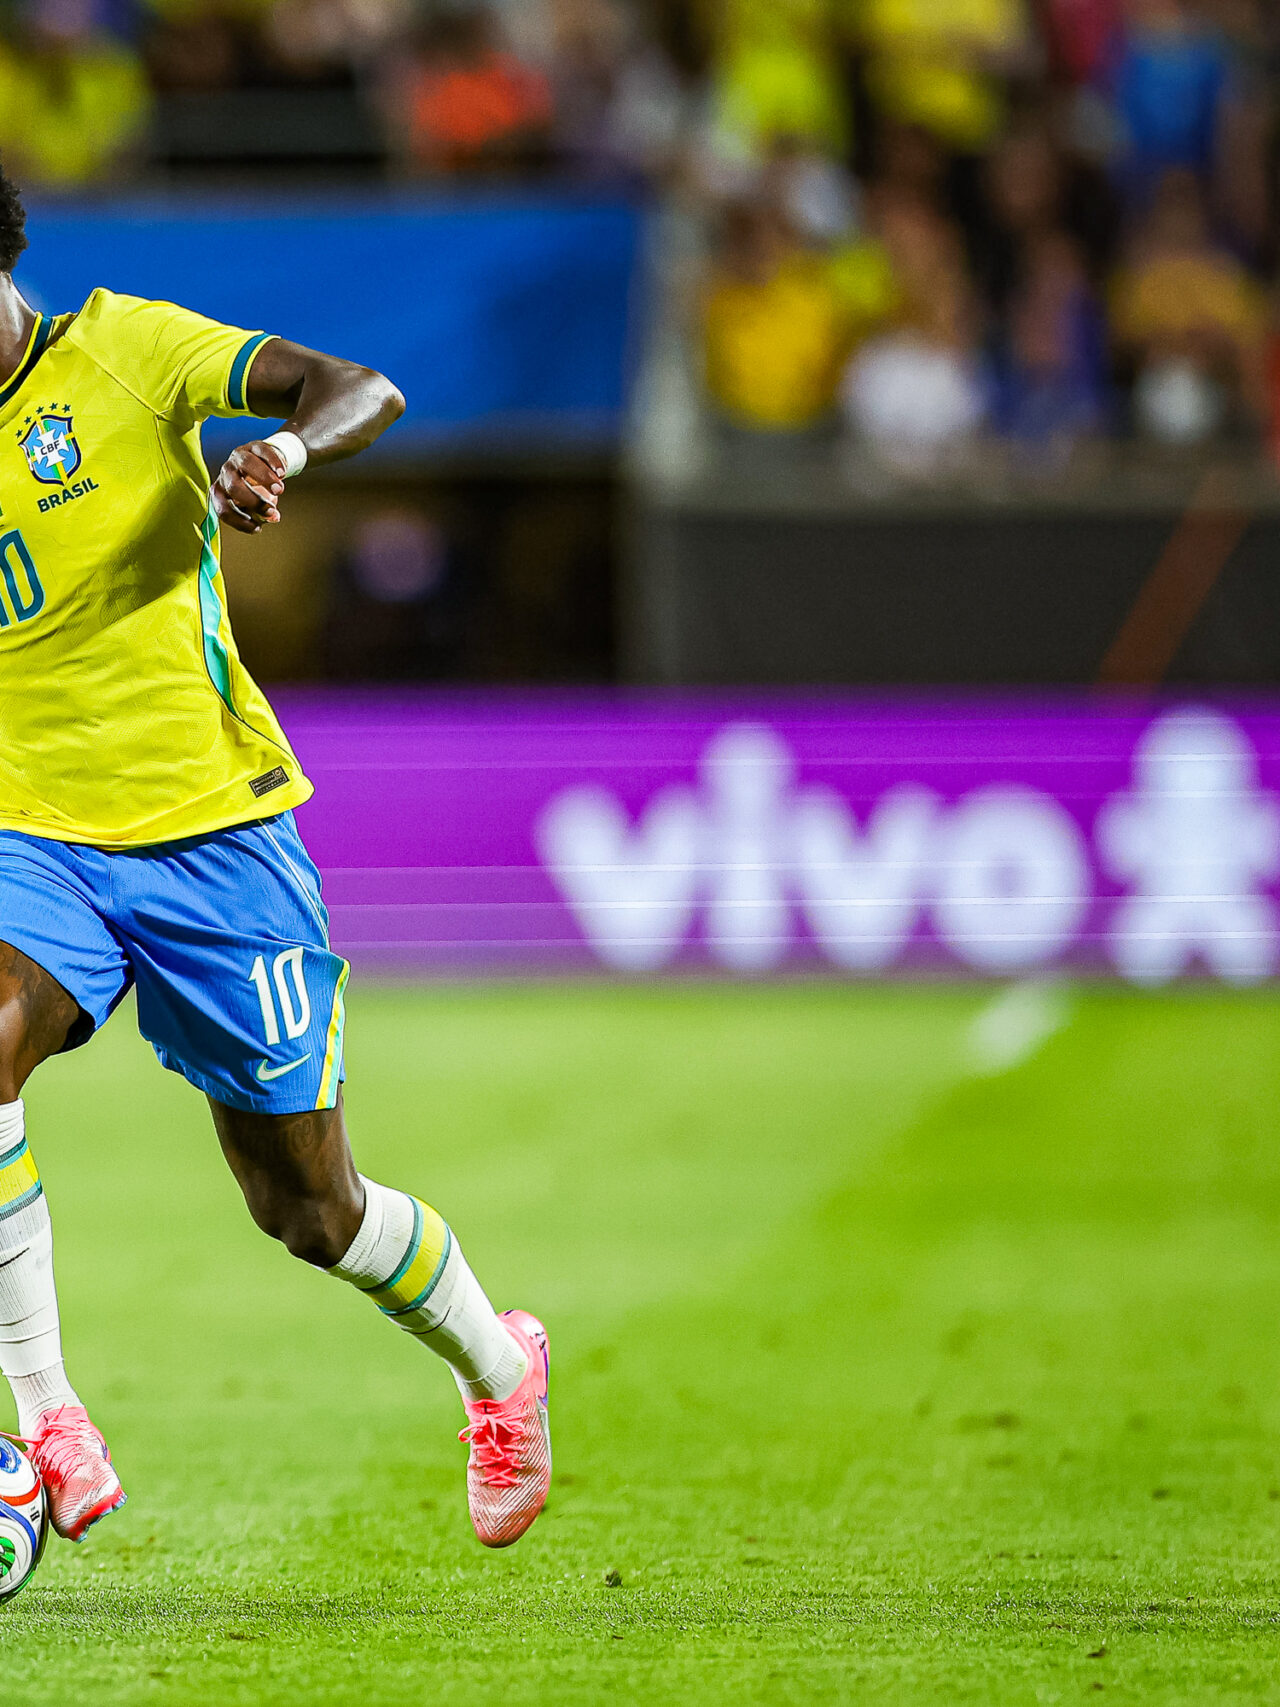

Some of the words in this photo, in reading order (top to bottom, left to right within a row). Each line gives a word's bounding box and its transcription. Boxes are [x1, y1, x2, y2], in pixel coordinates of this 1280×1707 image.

[40, 440, 61, 456] CBF
[37, 477, 100, 513] BRASIL
[535, 720, 1090, 972] vivo
[248, 946, 311, 1046] 10
